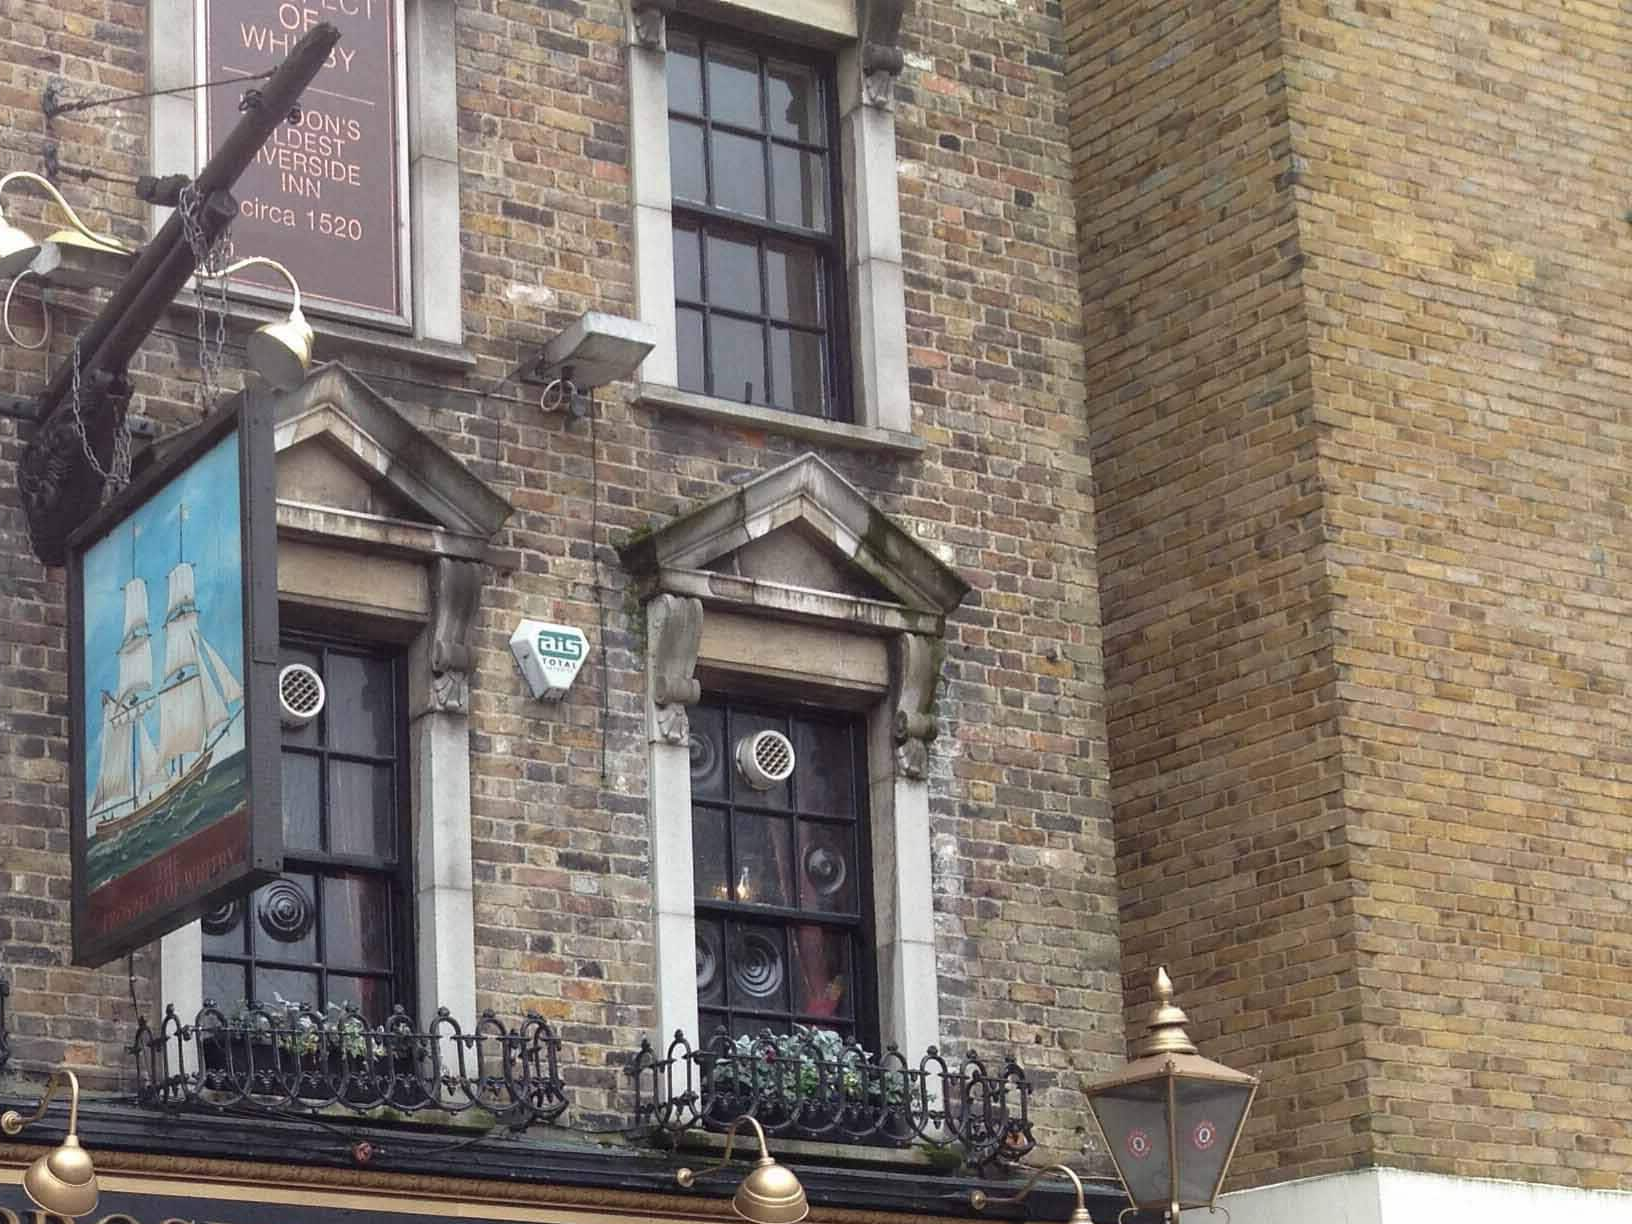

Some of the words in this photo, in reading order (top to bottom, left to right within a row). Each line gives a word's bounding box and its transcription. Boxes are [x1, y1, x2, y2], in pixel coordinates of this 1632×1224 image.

[279, 4, 319, 33] OF
[272, 128, 345, 158] LDEST
[256, 146, 361, 186] IVERSIDE
[281, 173, 321, 199] INN
[240, 197, 296, 226] circa
[306, 209, 362, 241] 1520
